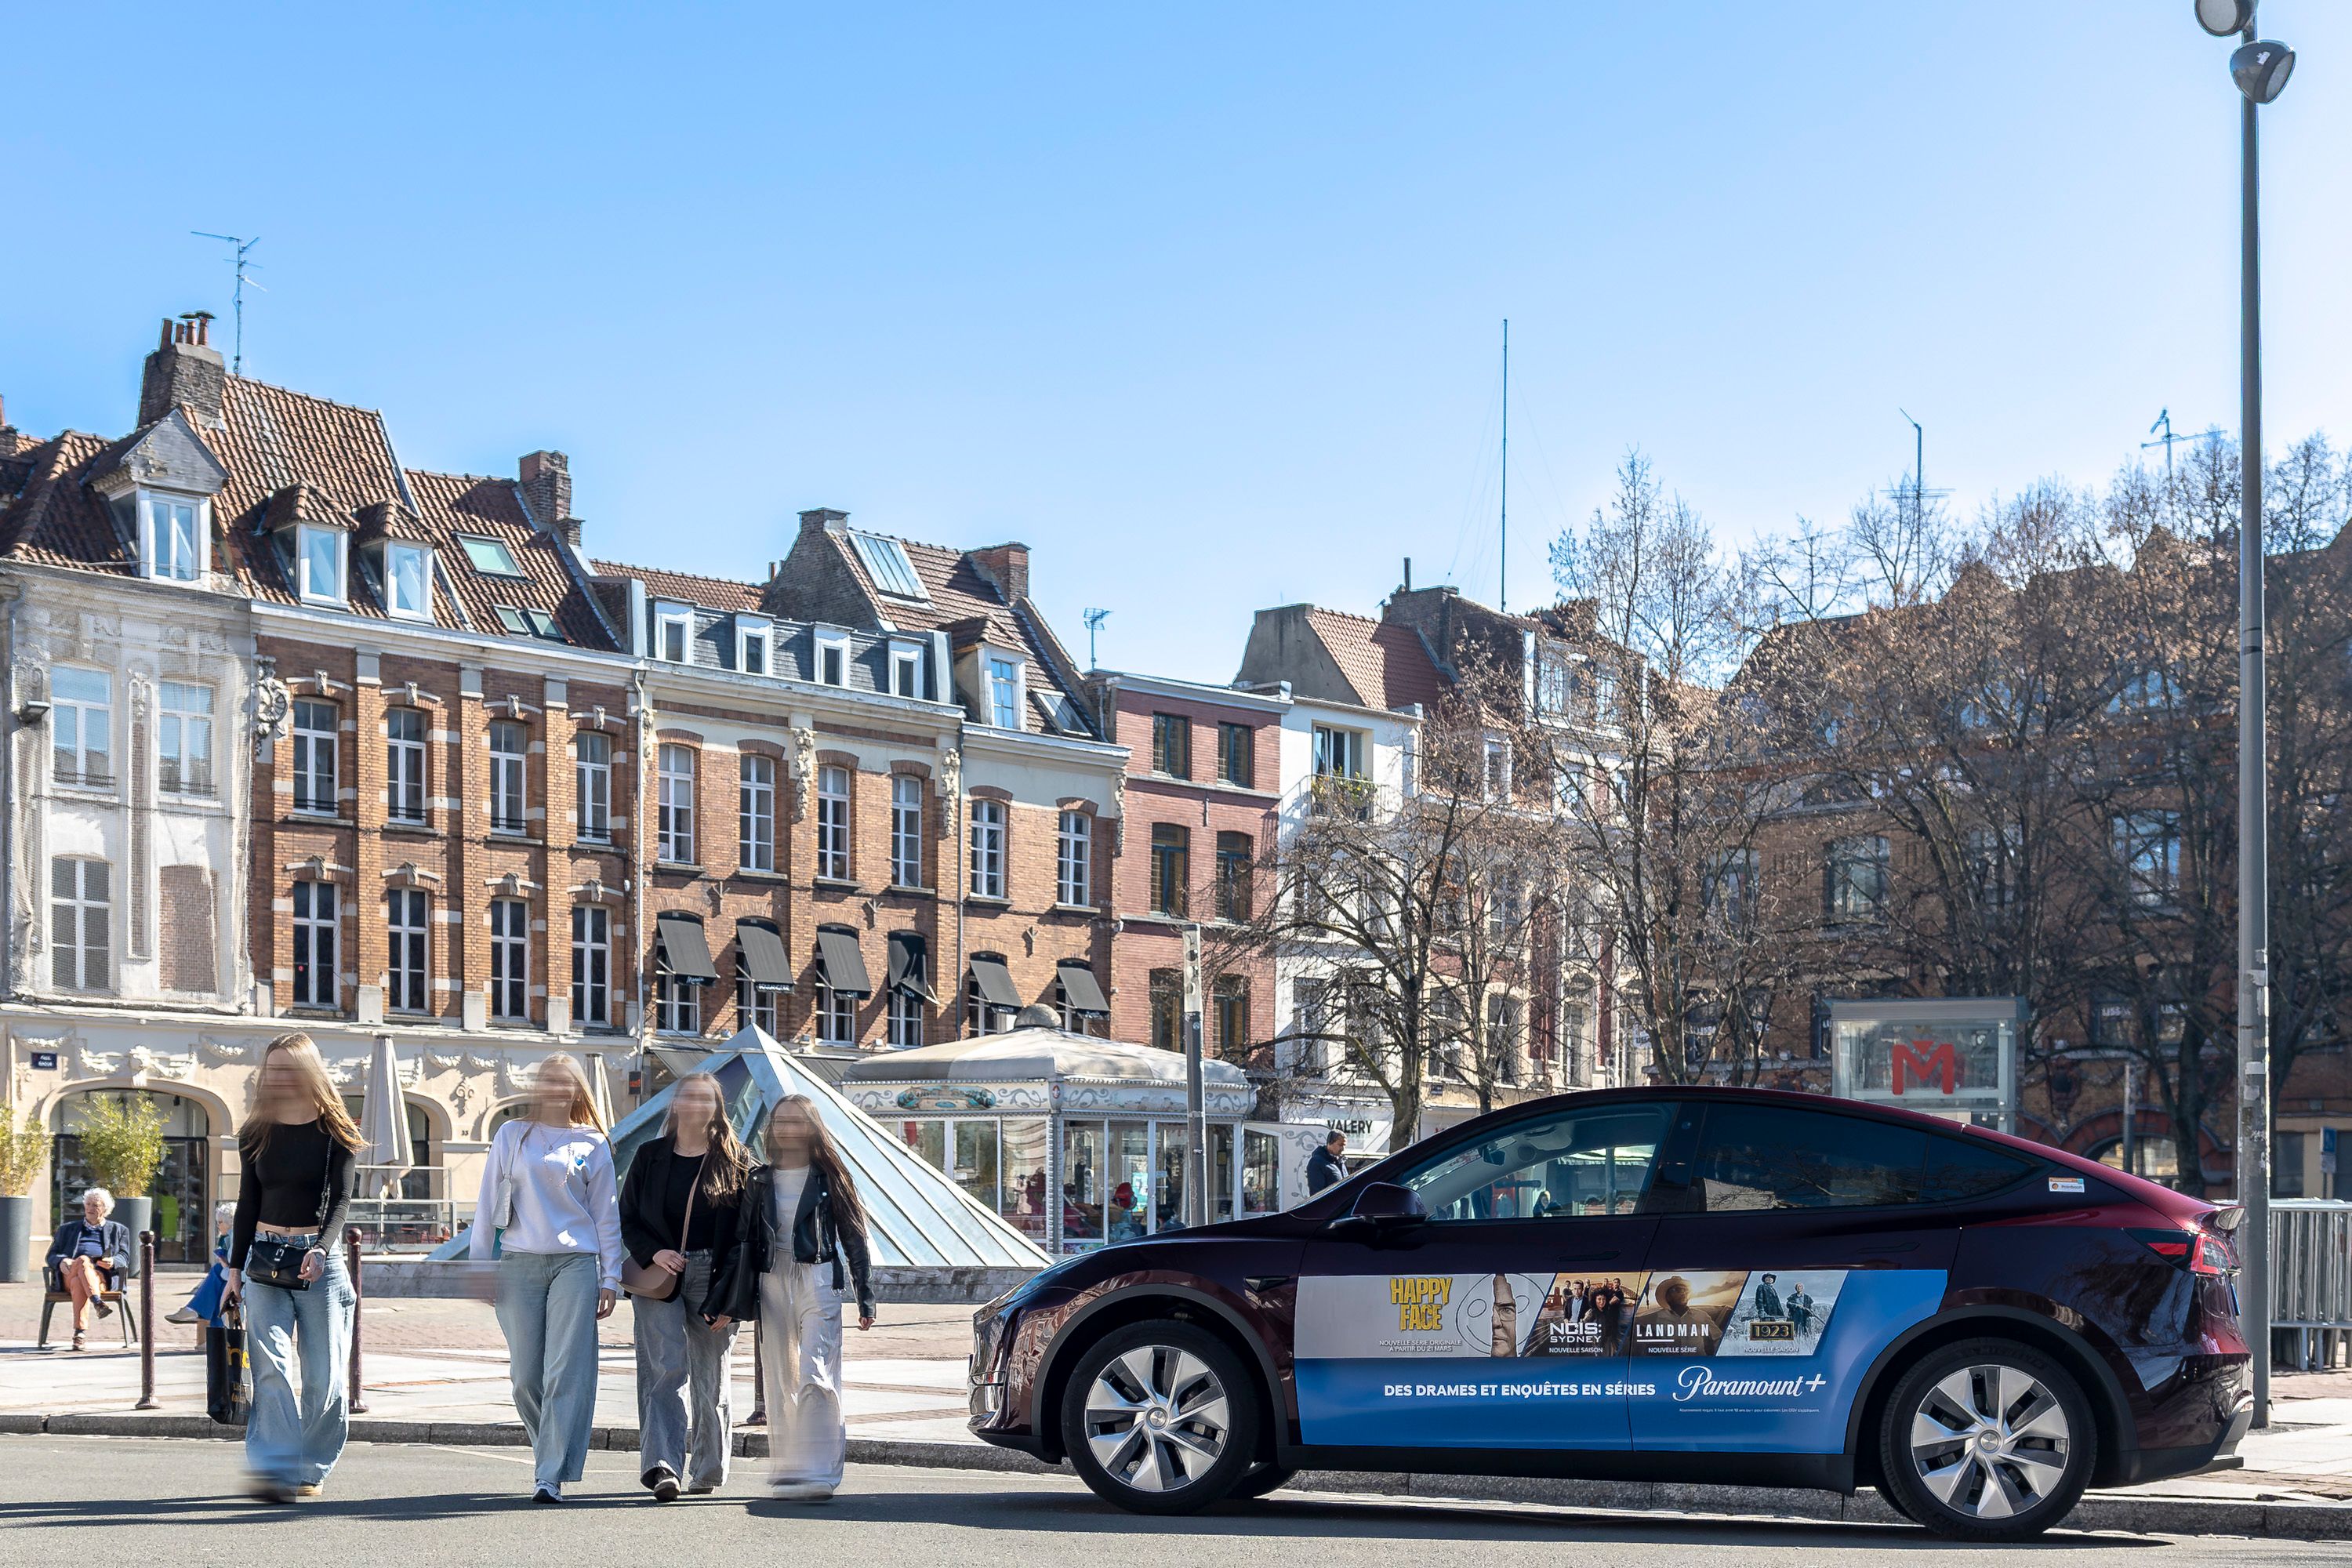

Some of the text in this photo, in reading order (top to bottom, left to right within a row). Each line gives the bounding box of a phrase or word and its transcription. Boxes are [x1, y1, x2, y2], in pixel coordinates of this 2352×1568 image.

[1327, 1120, 1373, 1134] VALERY
[1390, 1277, 1453, 1305] HAPPY
[1399, 1303, 1443, 1331] FACE
[1549, 1322, 1602, 1335] NCIS:
[1636, 1323, 1709, 1338] LANDMAN
[1755, 1325, 1789, 1338] 1923
[1385, 1381, 1656, 1399] DES DRAMES ET ENQUÊTES EN SÉRIES
[1671, 1365, 1827, 1402] Paramount+
